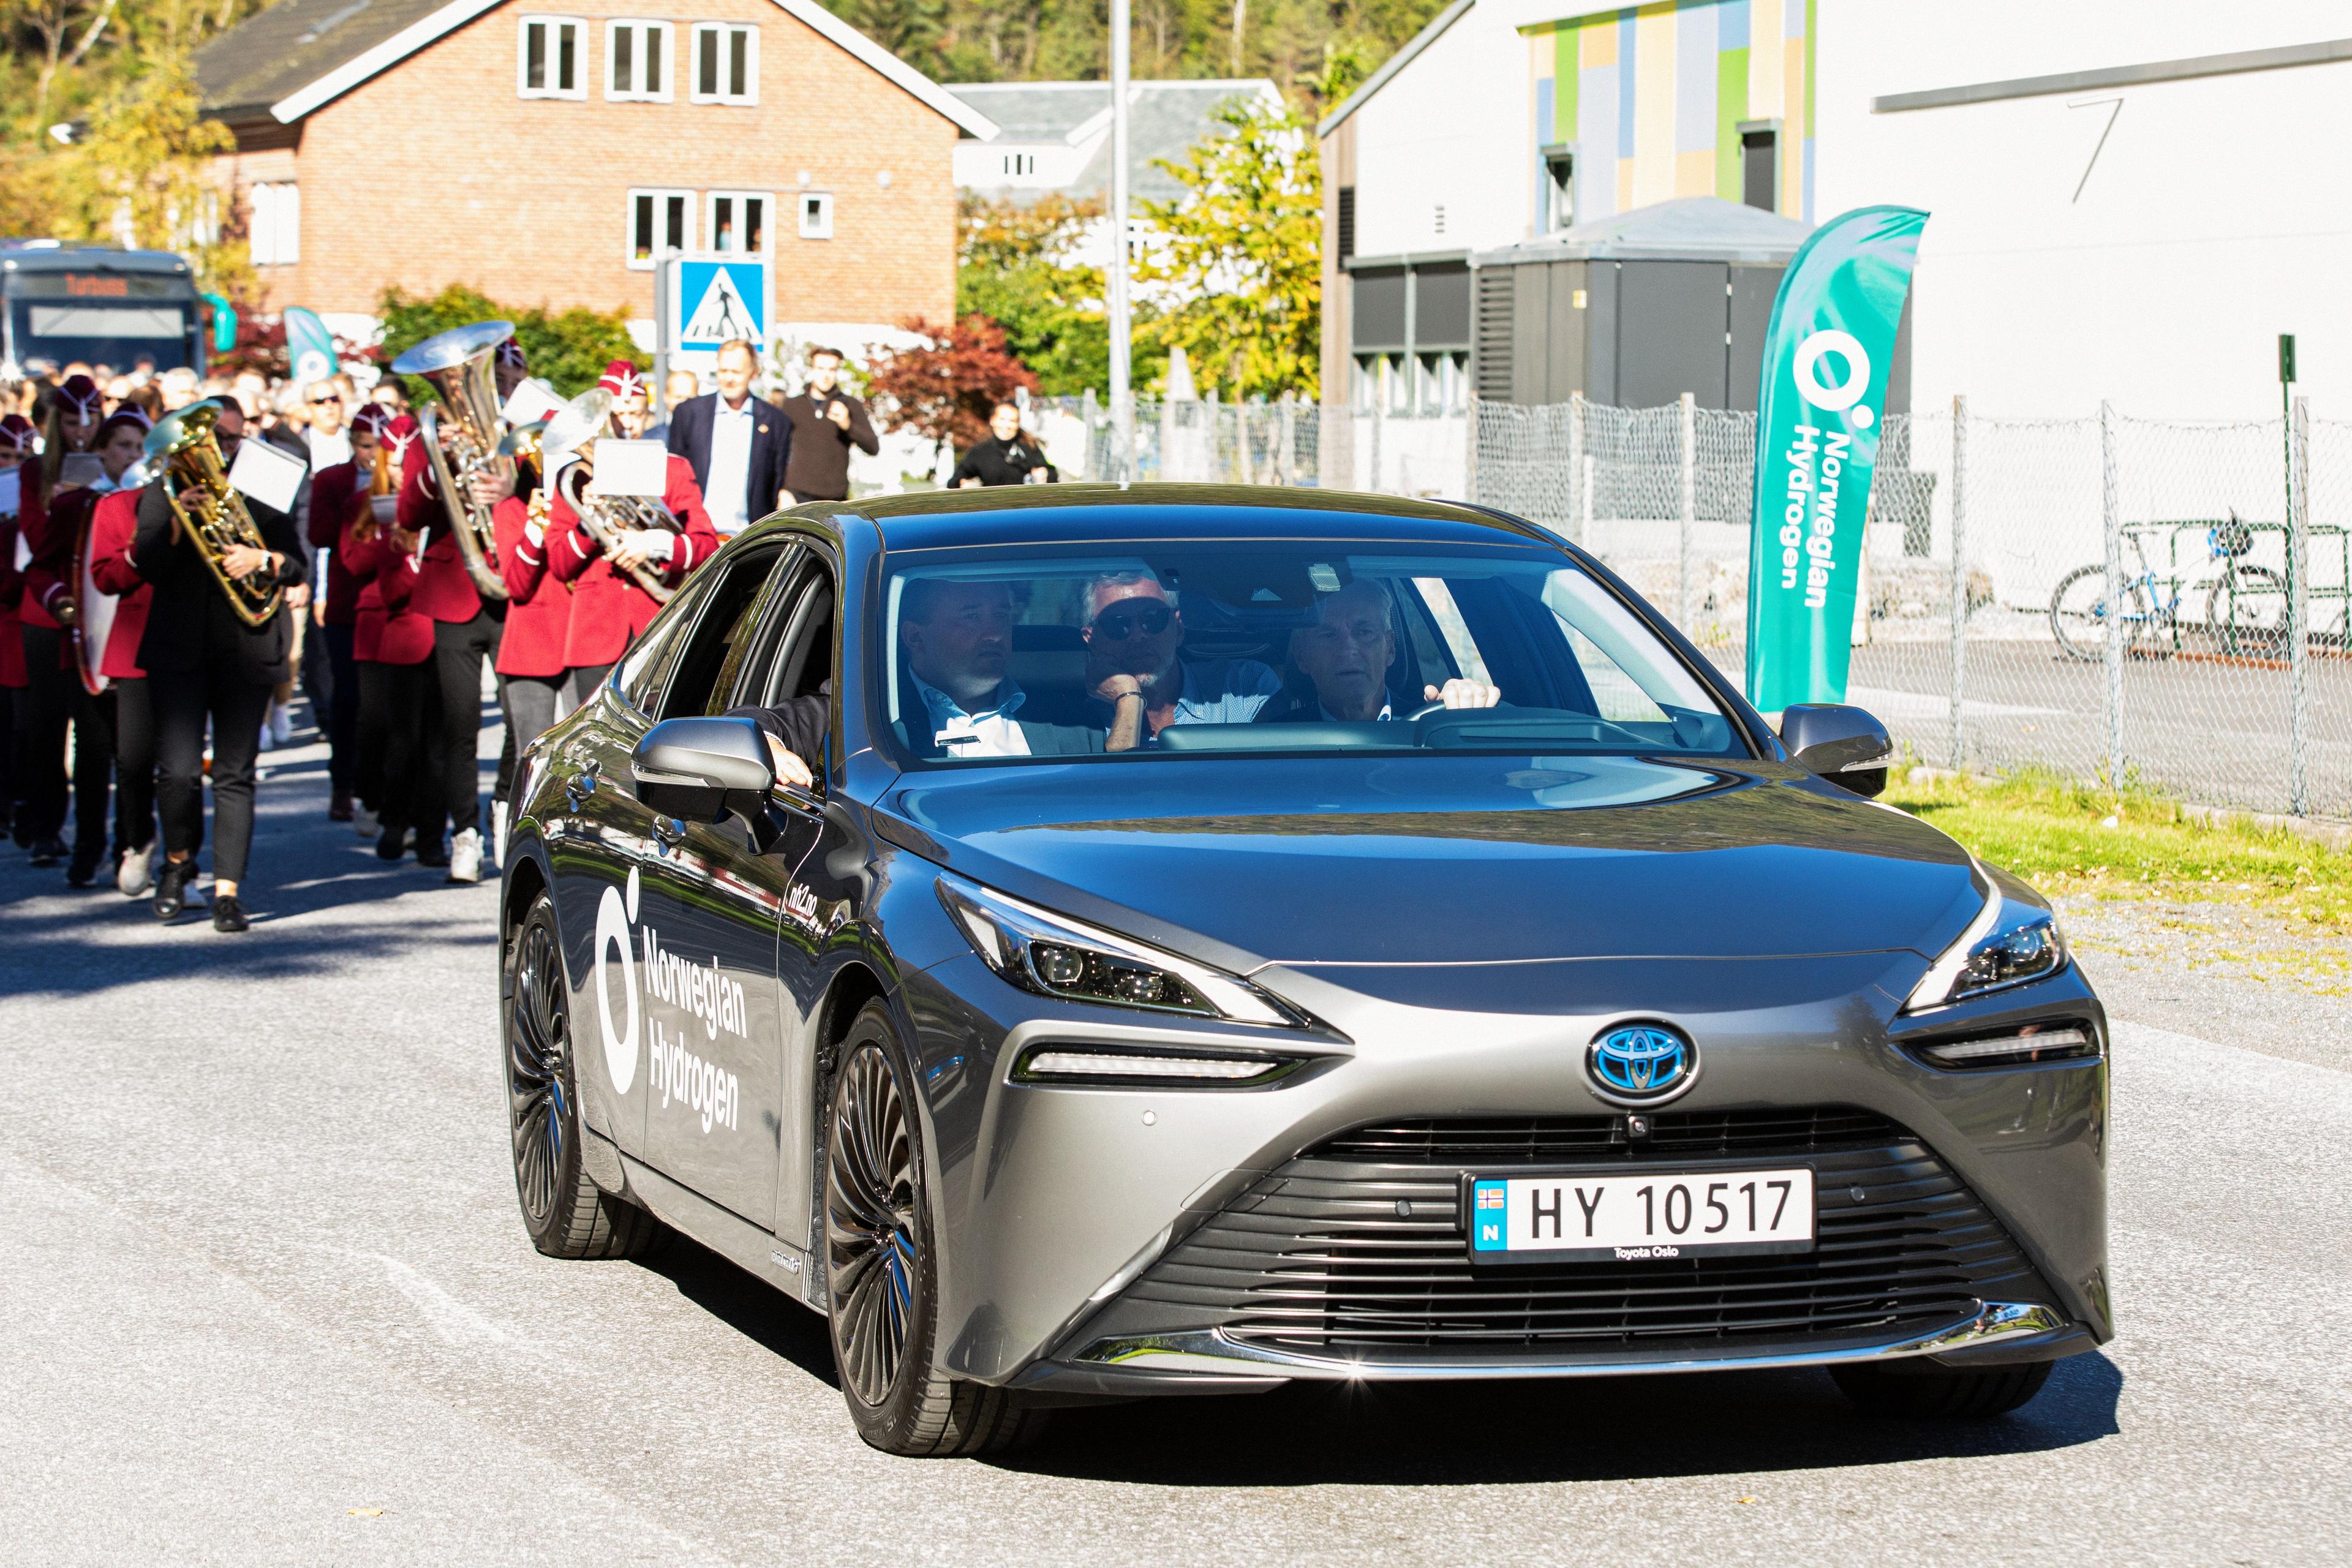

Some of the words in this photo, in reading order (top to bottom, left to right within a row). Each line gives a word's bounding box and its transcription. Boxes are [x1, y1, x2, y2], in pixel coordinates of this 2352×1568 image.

[1779, 424, 1820, 590] Hydrogen
[1804, 431, 1850, 609] Norwegian
[643, 925, 747, 1039] Norwegian
[649, 1017, 739, 1134] Hydrogen
[1482, 1225, 1499, 1241] N
[1532, 1187, 1605, 1239] HY
[1636, 1180, 1792, 1235] 10517
[1613, 1247, 1651, 1261] Toyota
[1651, 1245, 1679, 1257] Oslo
